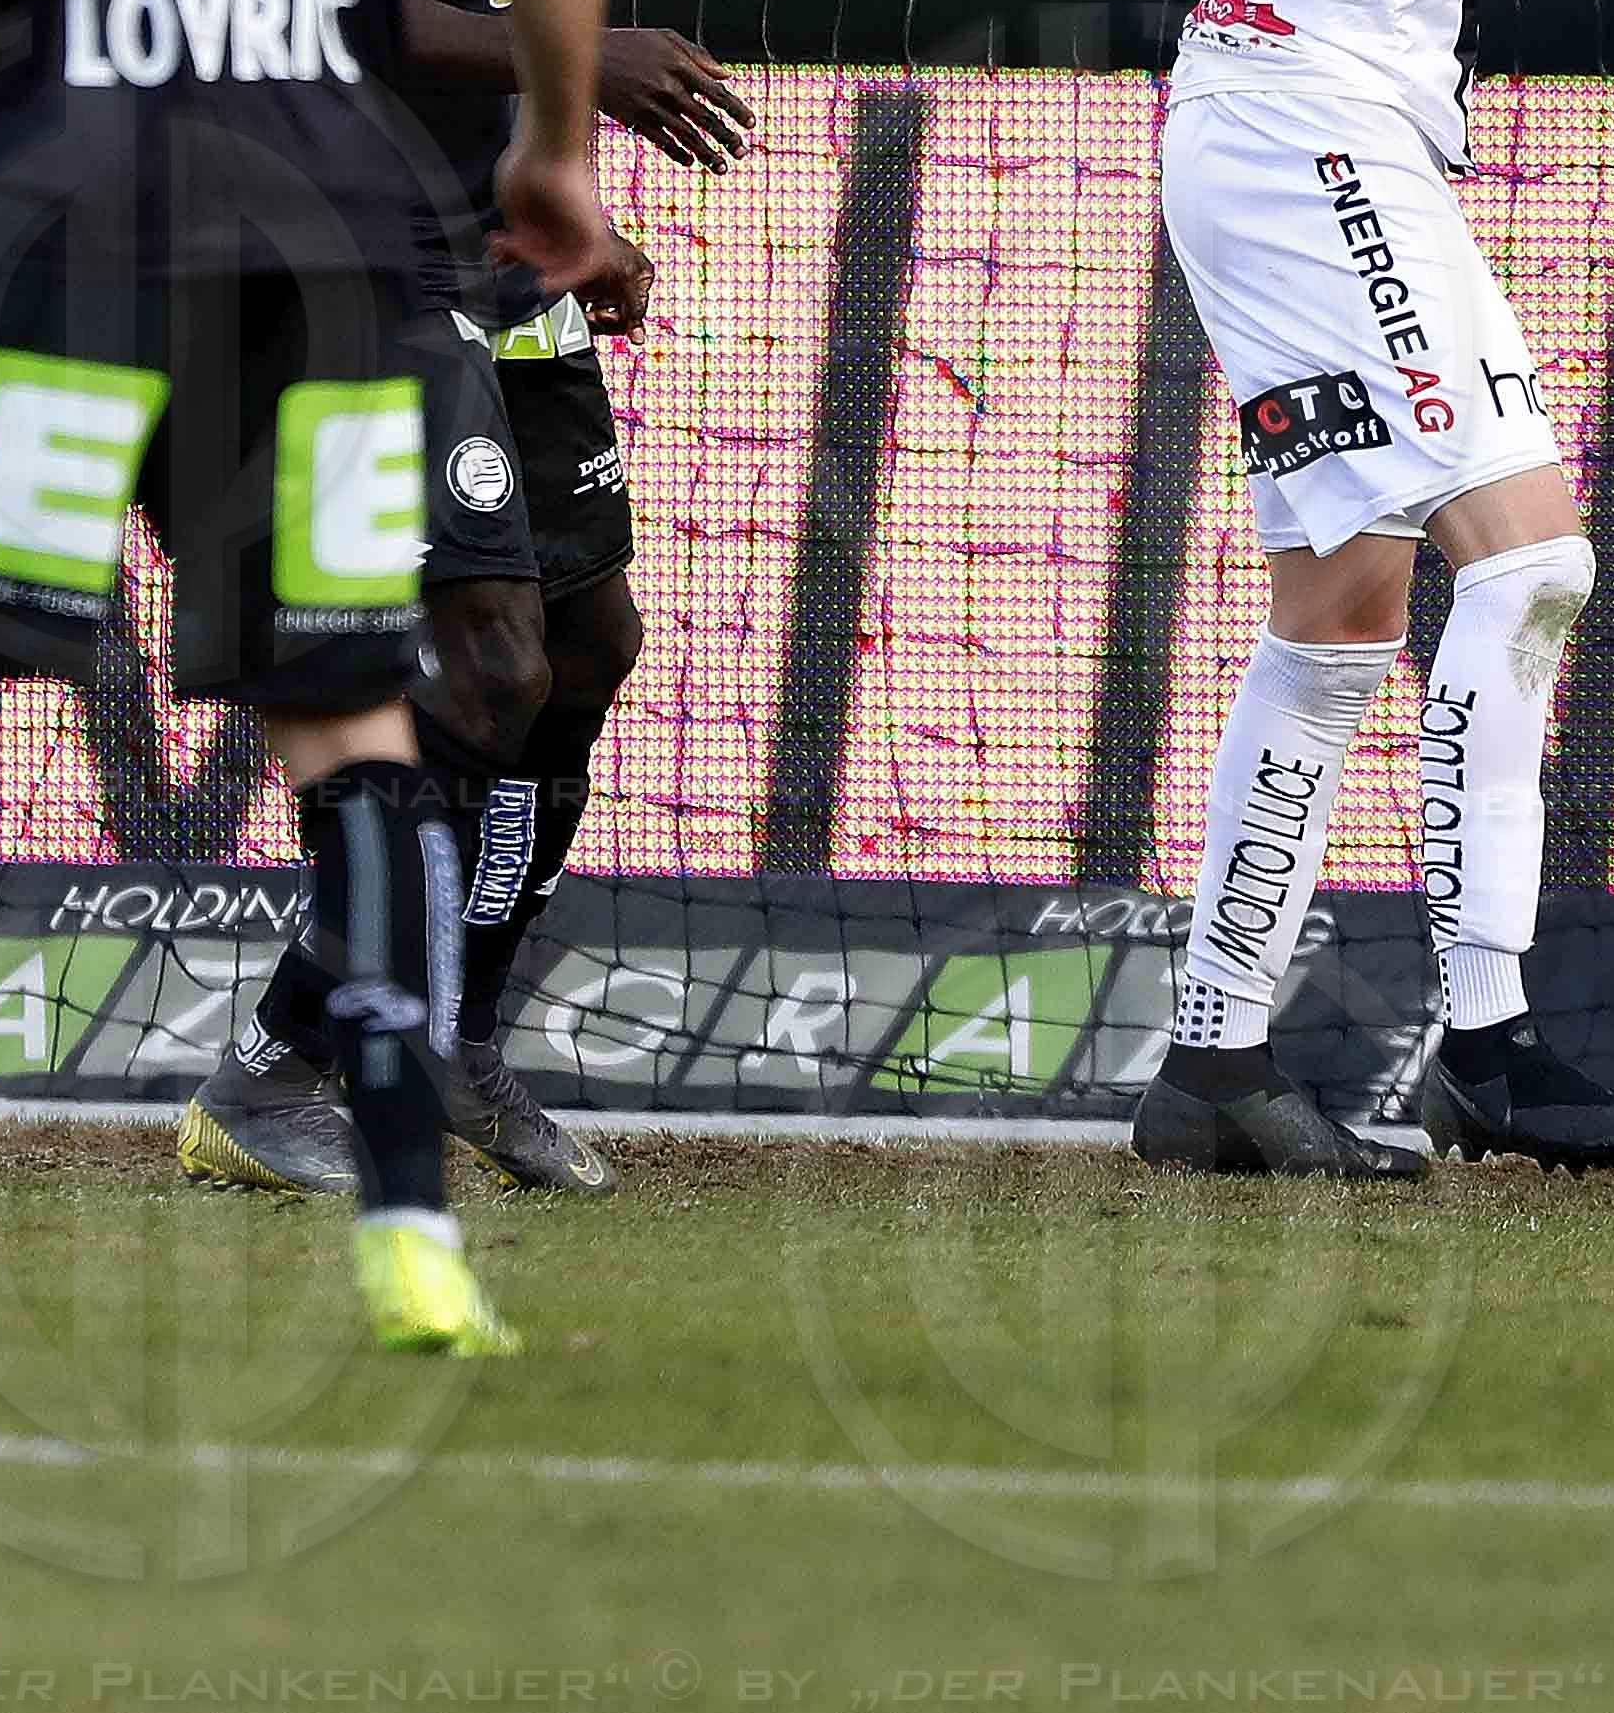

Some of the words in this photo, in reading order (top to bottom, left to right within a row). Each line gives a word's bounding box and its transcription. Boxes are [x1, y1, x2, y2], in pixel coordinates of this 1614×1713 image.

[1313, 152, 1430, 361] ENERGIE
[1395, 364, 1455, 435] AG
[1418, 684, 1477, 791] LUCE
[49, 884, 310, 933] HOLDIN
[1204, 838, 1297, 972] MOLTO
[1258, 747, 1326, 844] LUCE
